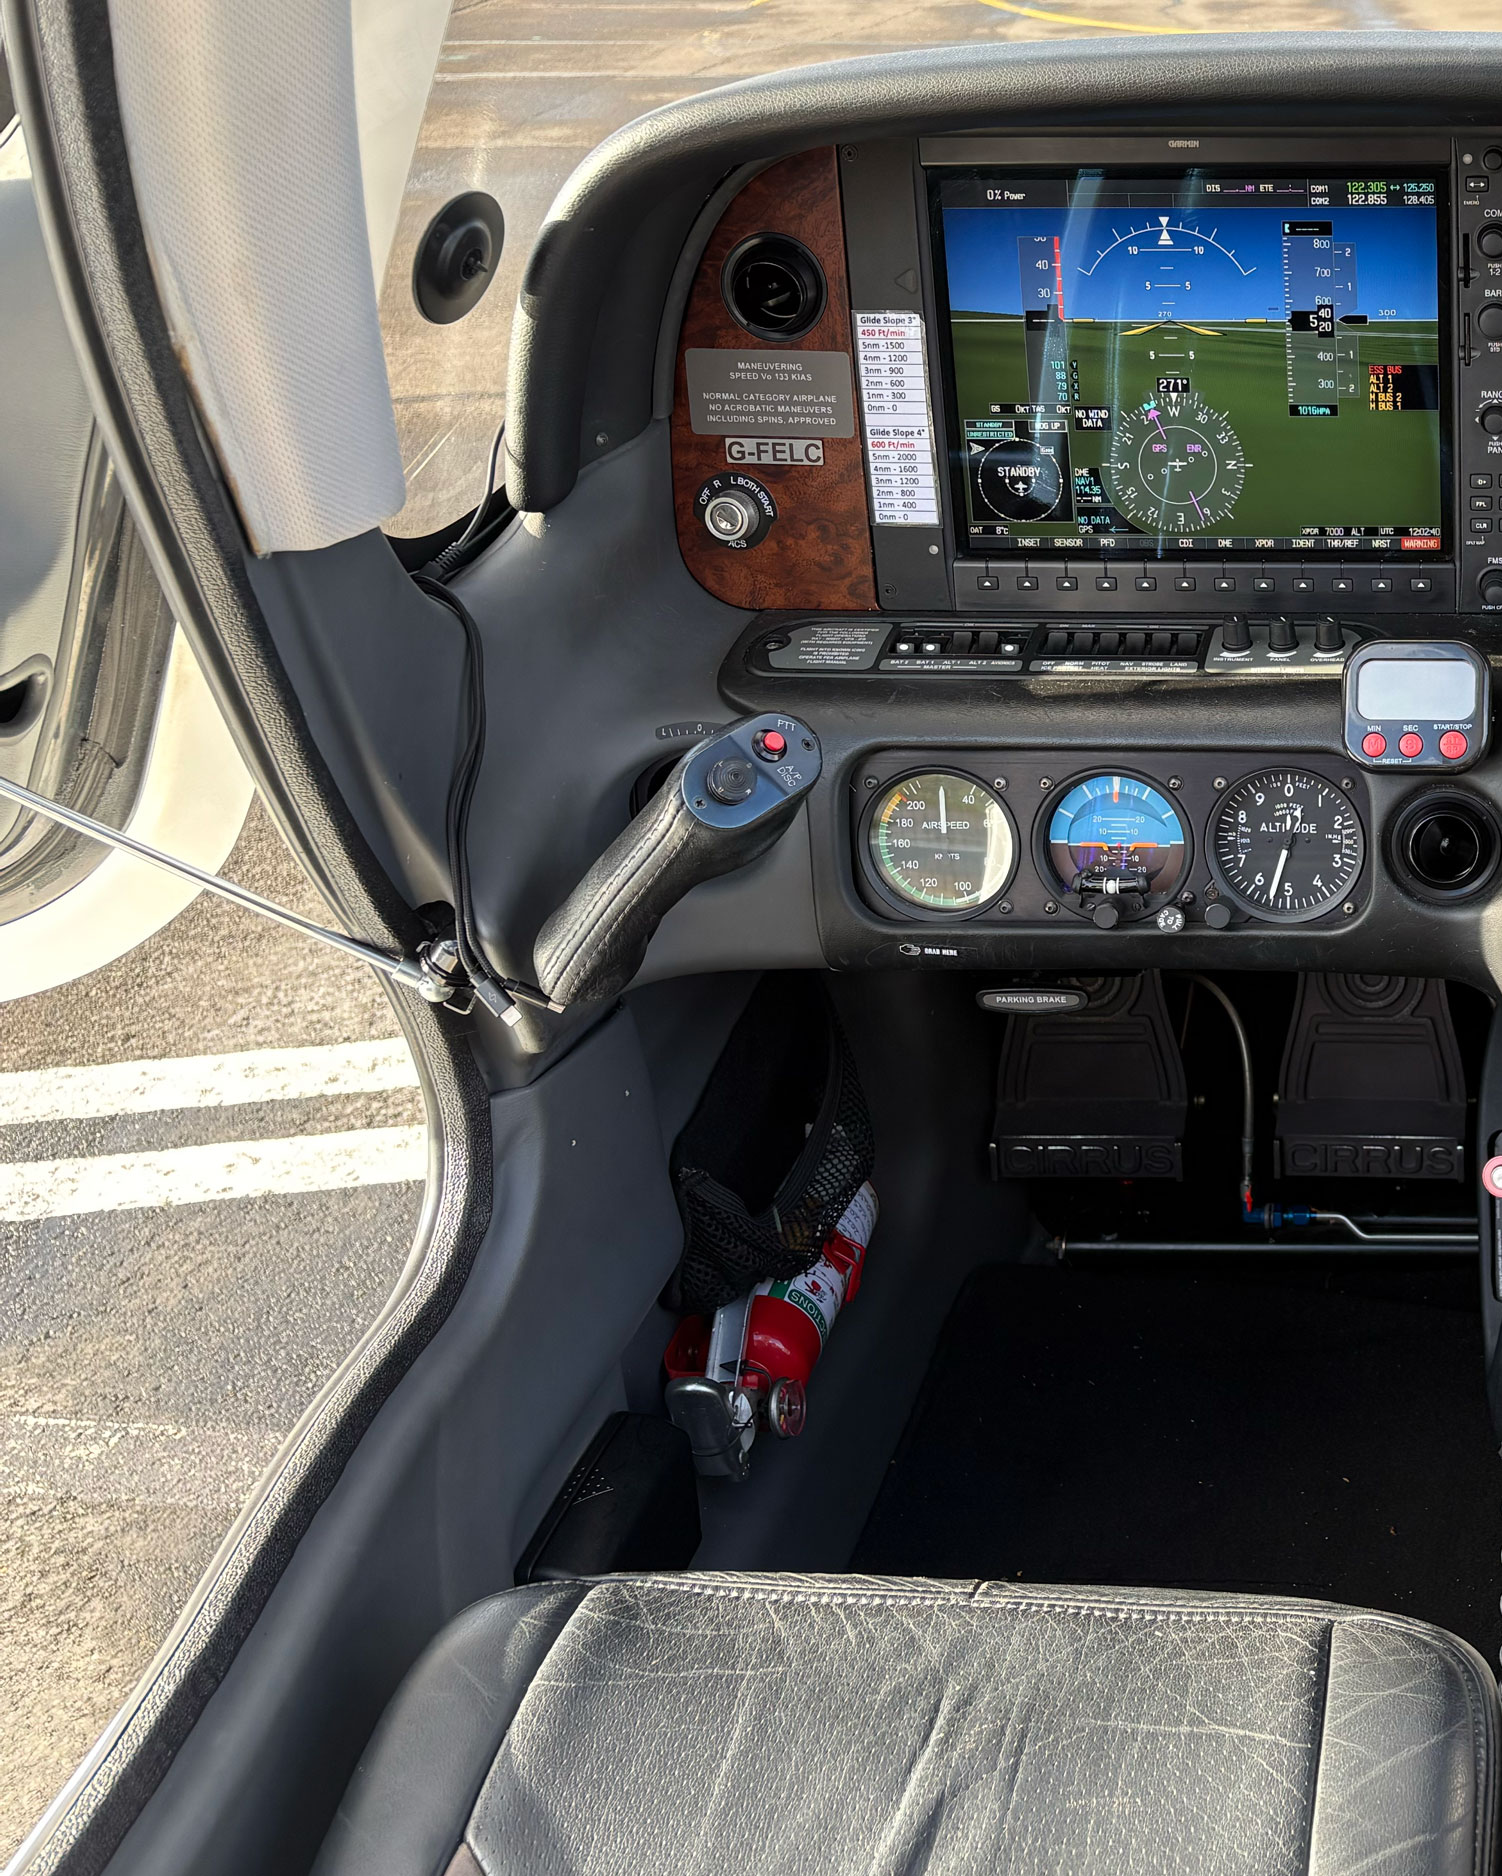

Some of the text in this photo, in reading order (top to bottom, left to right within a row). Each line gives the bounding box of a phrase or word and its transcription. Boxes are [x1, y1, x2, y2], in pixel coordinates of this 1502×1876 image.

[1168, 140, 1199, 148] GARMIN
[1311, 182, 1434, 193] COM1 122.305 125.250
[987, 190, 1025, 200] 0% Power
[1311, 195, 1434, 205] COM2 122.855 128.405
[860, 316, 881, 324] Glide
[883, 317, 905, 326] Slope
[878, 329, 905, 337] Ft/min
[738, 362, 802, 370] MANEUVERING
[730, 372, 758, 380] SPEED
[724, 404, 775, 412] ACROBATIC
[1075, 410, 1108, 418] NO WIND
[707, 415, 755, 423] INCLUDING
[788, 417, 836, 425] APPROVED
[1083, 419, 1103, 427] DATA
[870, 429, 891, 437] Glide
[893, 429, 915, 438] Slope
[871, 441, 915, 449] 600 Ft/min
[727, 441, 821, 463] G-FELC
[998, 467, 1040, 477] STANDBY
[700, 487, 710, 504] OFF
[758, 492, 774, 517] START
[1325, 528, 1344, 536] 7000
[1351, 528, 1365, 536] ALT
[1018, 539, 1040, 547] INSET
[1054, 539, 1083, 547] SENSOR
[1100, 539, 1115, 547] PFD
[1179, 539, 1193, 547] CDI
[1218, 539, 1232, 547] DME
[1255, 539, 1274, 547] XPDR
[1292, 539, 1315, 547] IDENT
[1372, 539, 1391, 547] NRST
[1404, 539, 1437, 548] WARNING
[777, 719, 796, 731] PTT
[777, 767, 796, 787] DISC
[907, 801, 925, 809] 200
[893, 840, 910, 848] 160
[920, 879, 937, 887] 120
[1005, 1146, 1174, 1174] CIRRUS
